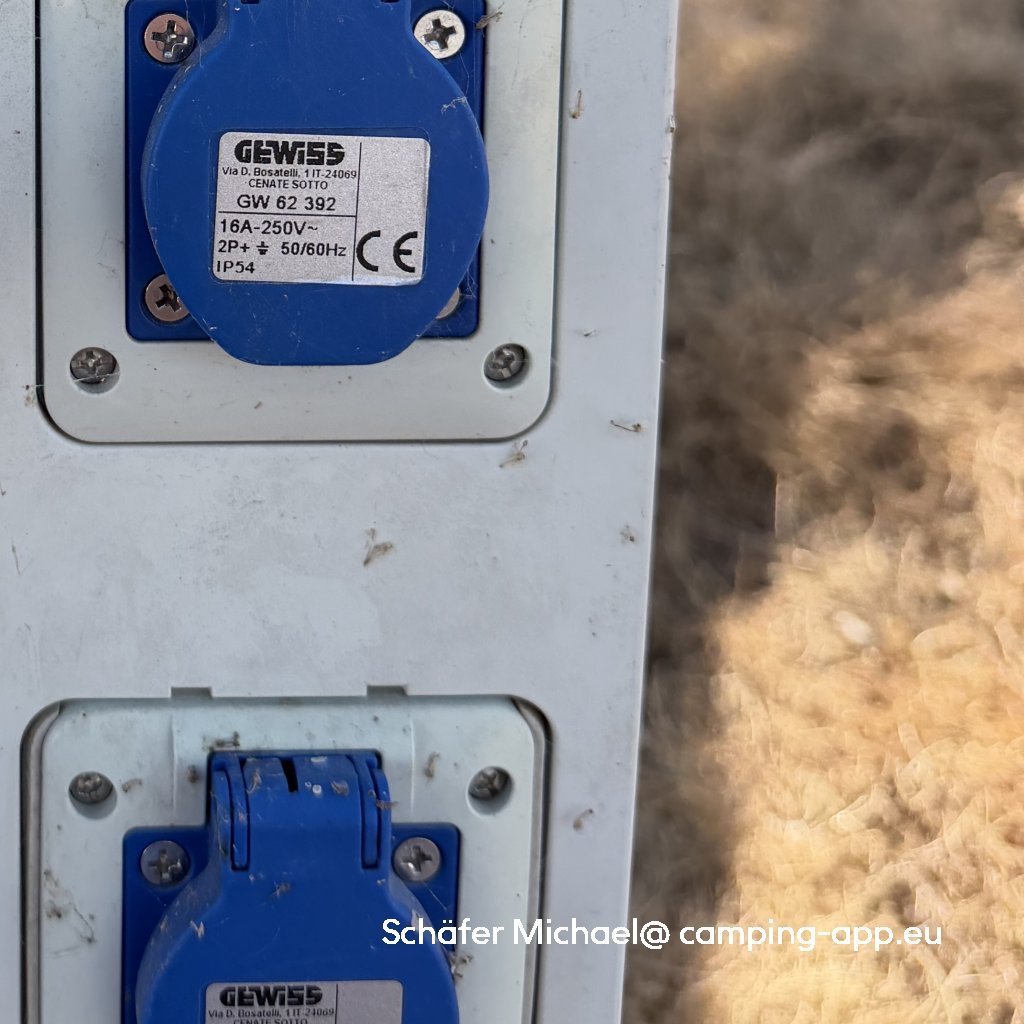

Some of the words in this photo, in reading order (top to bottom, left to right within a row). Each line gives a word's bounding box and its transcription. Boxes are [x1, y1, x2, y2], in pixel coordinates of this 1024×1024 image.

[222, 167, 238, 176] Via
[241, 167, 251, 176] D.
[254, 168, 301, 178] Bosatelli,
[312, 169, 357, 179] IT-24069
[248, 178, 289, 189] CENATE
[292, 179, 328, 190] SOTTO
[237, 194, 270, 209] GW
[276, 195, 297, 210] 62
[304, 196, 336, 211] 392
[217, 240, 250, 254] 2P+
[281, 242, 346, 257] 50/60Hz
[356, 230, 418, 273] CE
[216, 260, 255, 274] IP54
